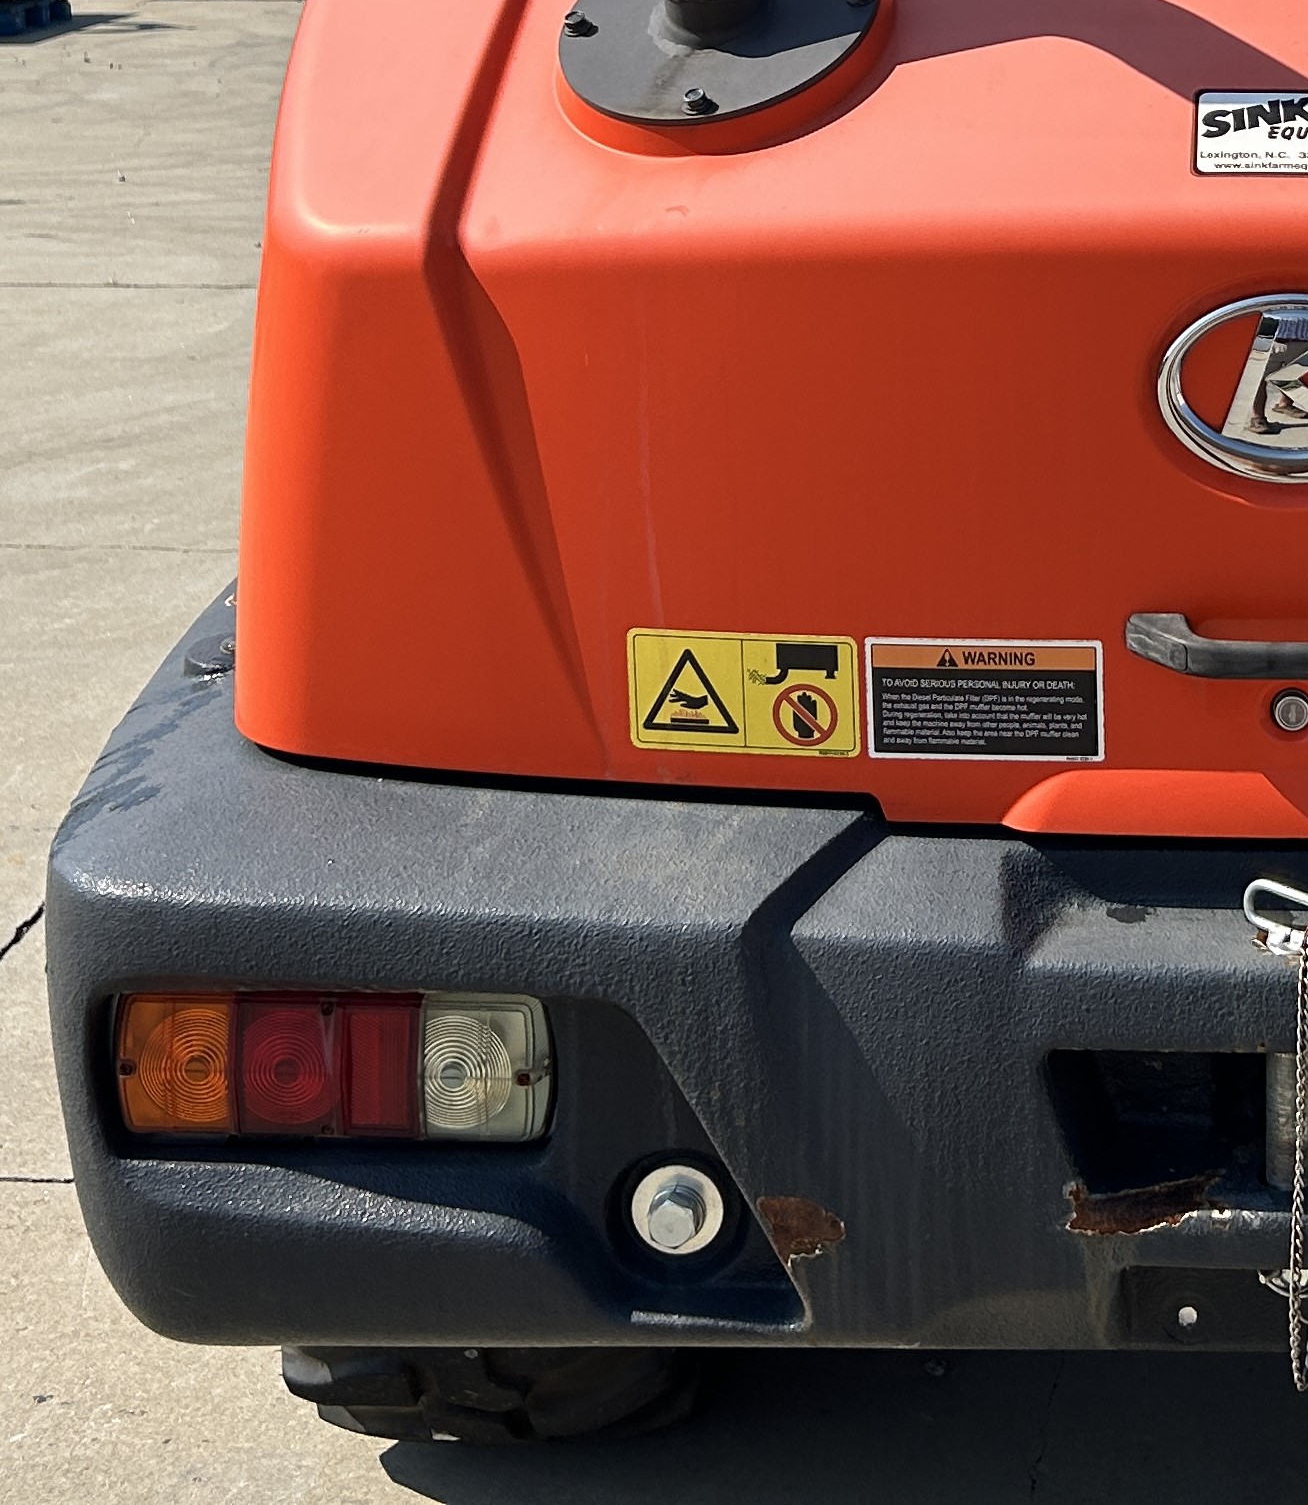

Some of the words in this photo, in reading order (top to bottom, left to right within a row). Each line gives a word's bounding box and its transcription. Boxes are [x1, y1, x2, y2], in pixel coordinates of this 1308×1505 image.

[962, 651, 1035, 666] WARNING
[882, 678, 893, 687] TO
[894, 679, 918, 688] AVOID
[920, 679, 956, 688] SERIOUS
[957, 680, 1001, 689] PERSONAL
[1002, 681, 1030, 689] INJURY
[1032, 681, 1045, 689] OR
[1046, 681, 1075, 689] DEATH:
